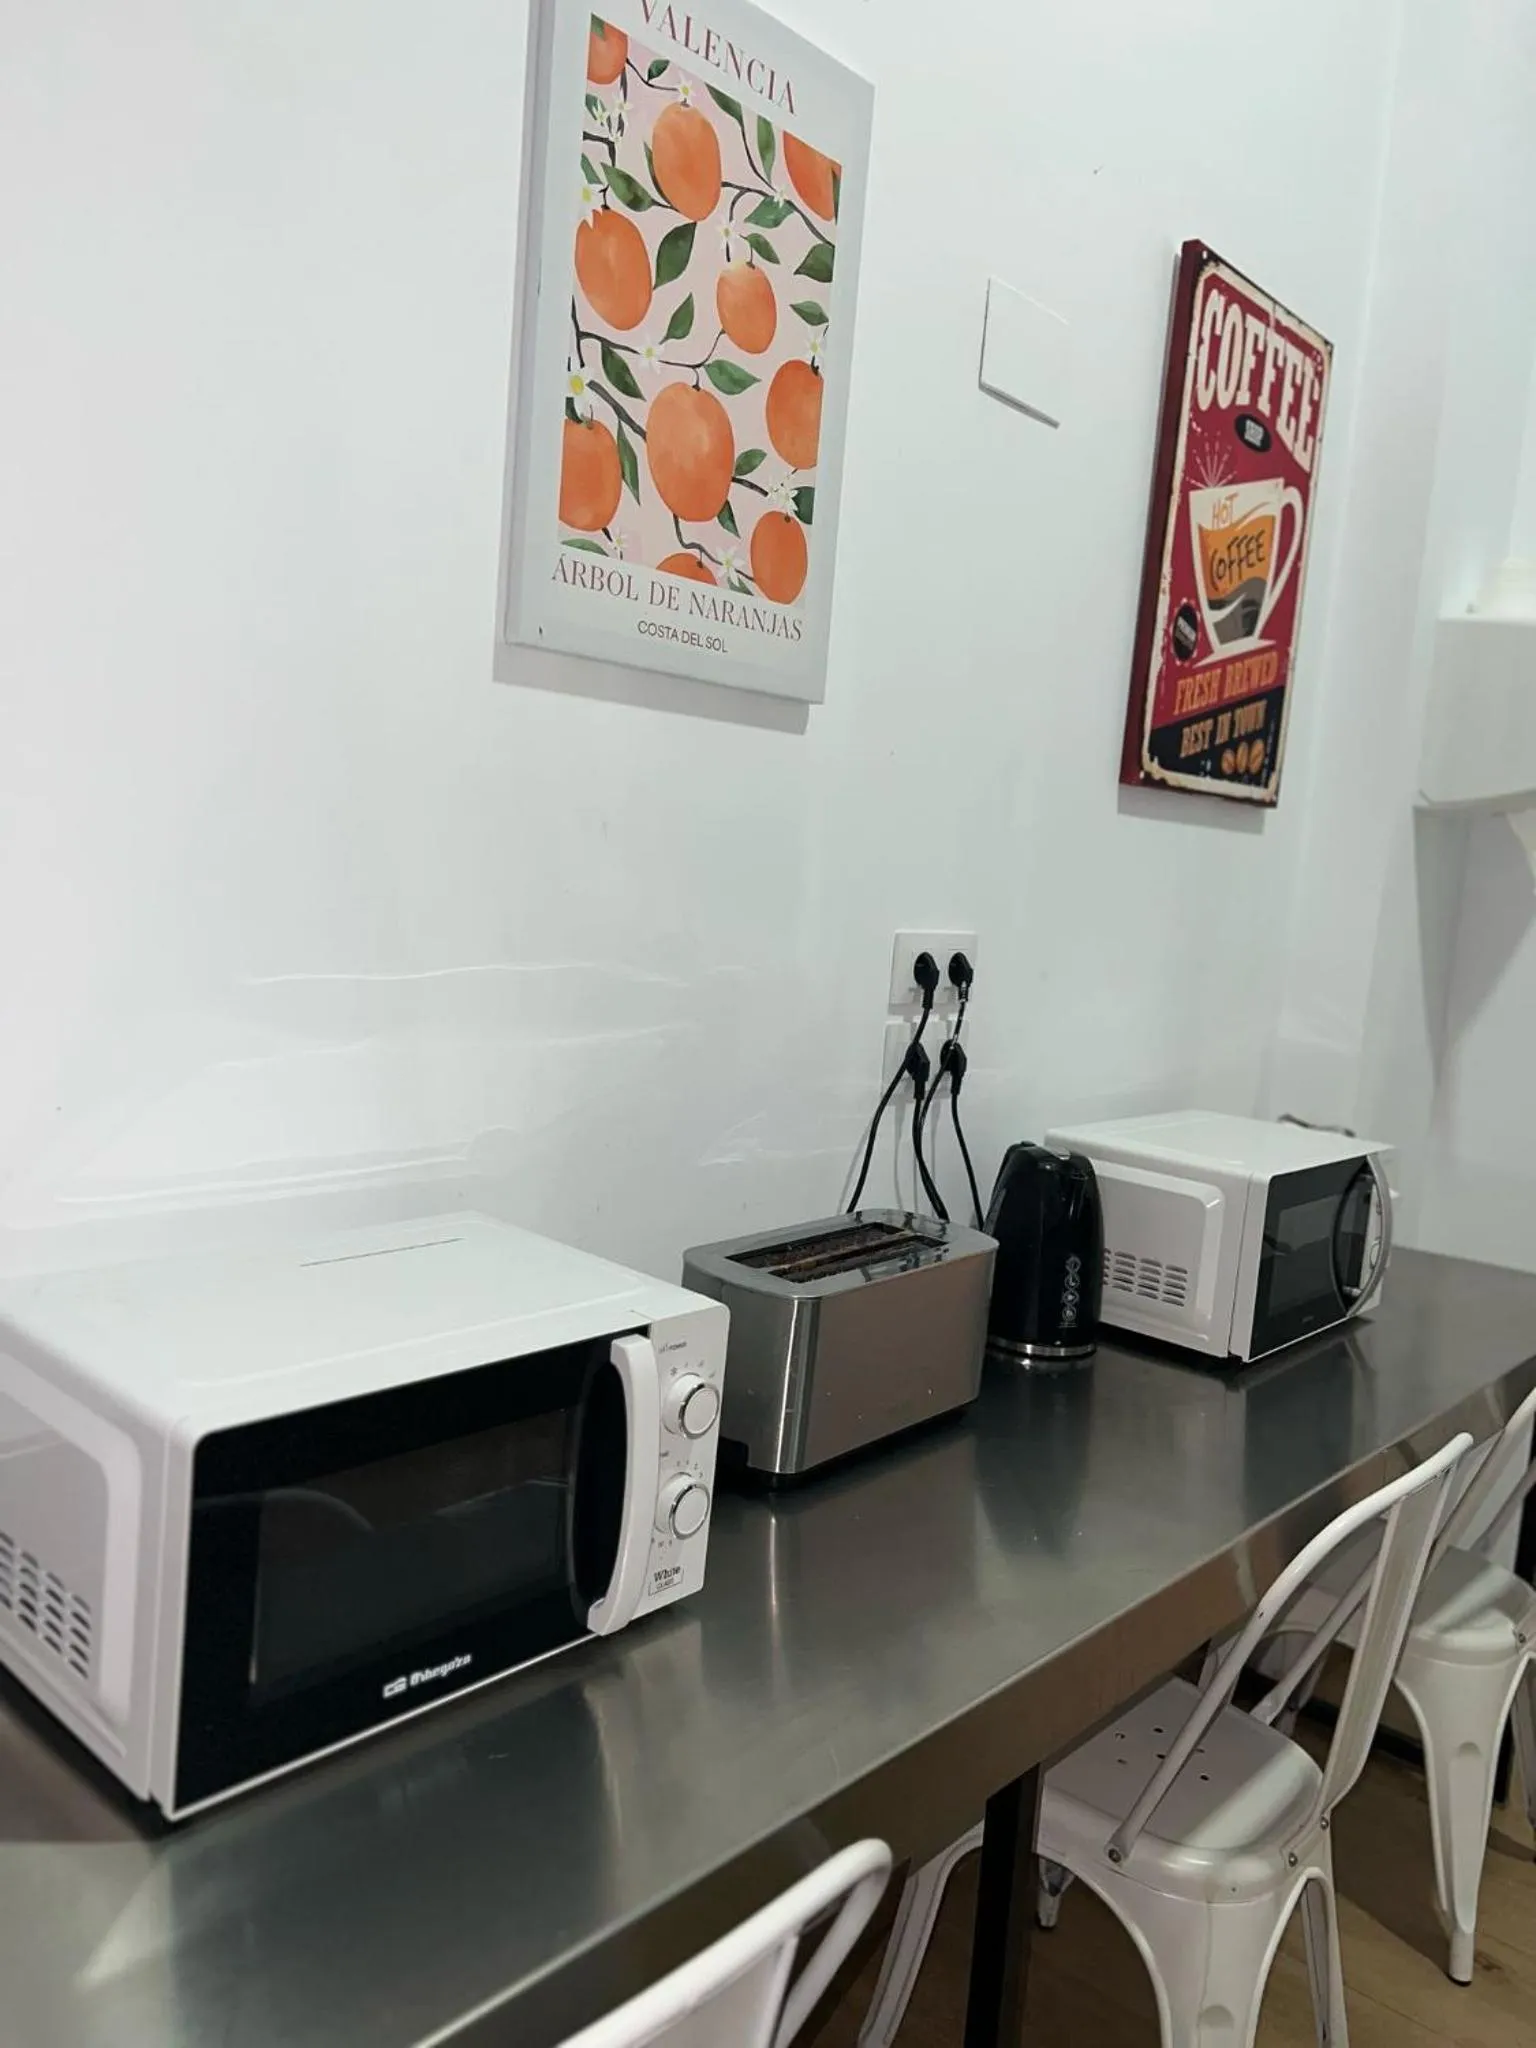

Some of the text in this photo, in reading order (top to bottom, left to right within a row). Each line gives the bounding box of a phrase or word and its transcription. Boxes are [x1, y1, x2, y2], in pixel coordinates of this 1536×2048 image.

[641, 0, 796, 115] VALENCIA
[1196, 288, 1320, 473] COFFEE
[1212, 493, 1239, 529] HOT
[551, 553, 803, 642] ÁRBOL DE NARANJAS
[637, 620, 728, 653] COSTA DEL SOL
[1173, 651, 1279, 716] FRESH BREWED
[1180, 718, 1214, 759] BEST
[1214, 711, 1232, 746] IN
[1232, 699, 1268, 738] TOWN
